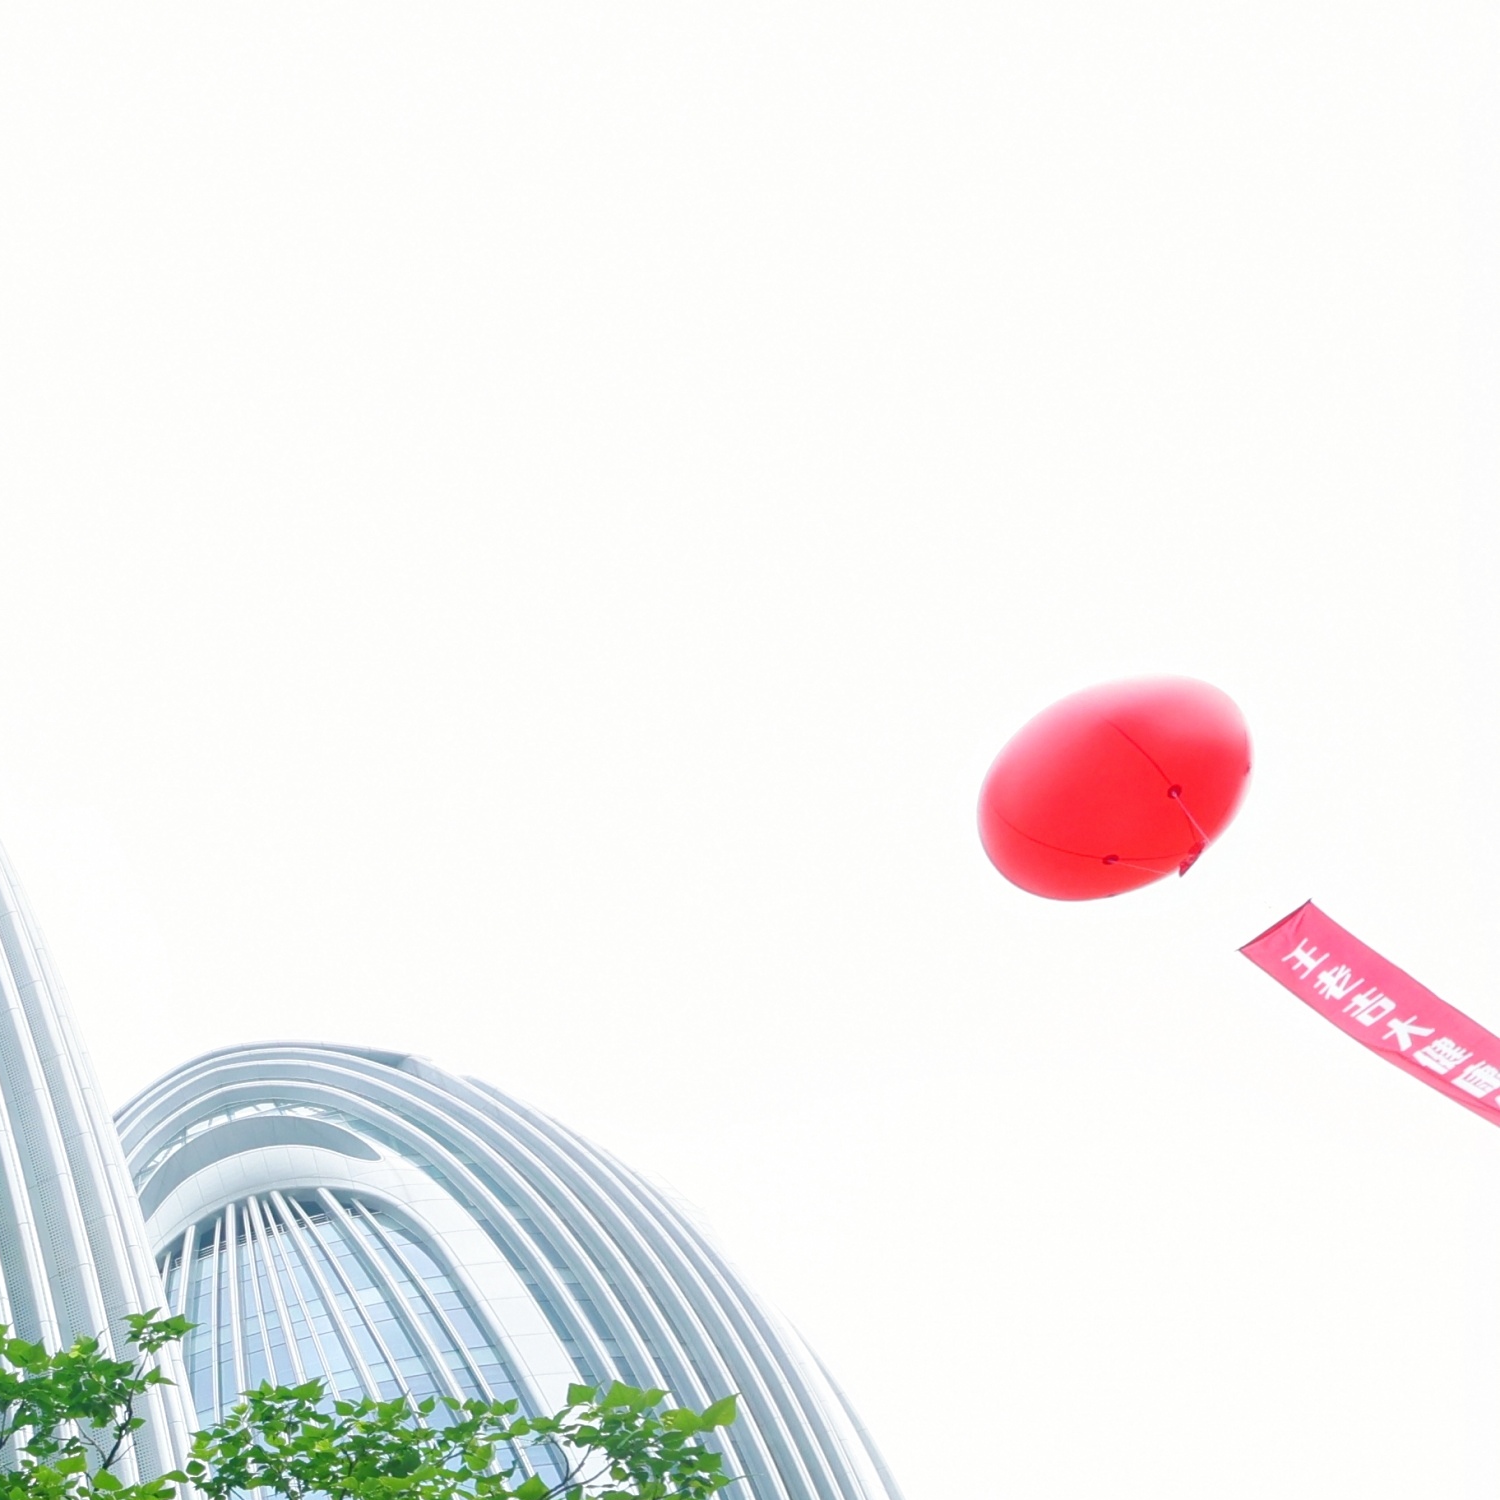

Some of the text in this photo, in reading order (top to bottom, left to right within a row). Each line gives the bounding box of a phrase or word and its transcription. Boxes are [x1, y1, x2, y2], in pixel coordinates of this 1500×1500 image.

[1281, 938, 1500, 1106] 王老吉大健康
